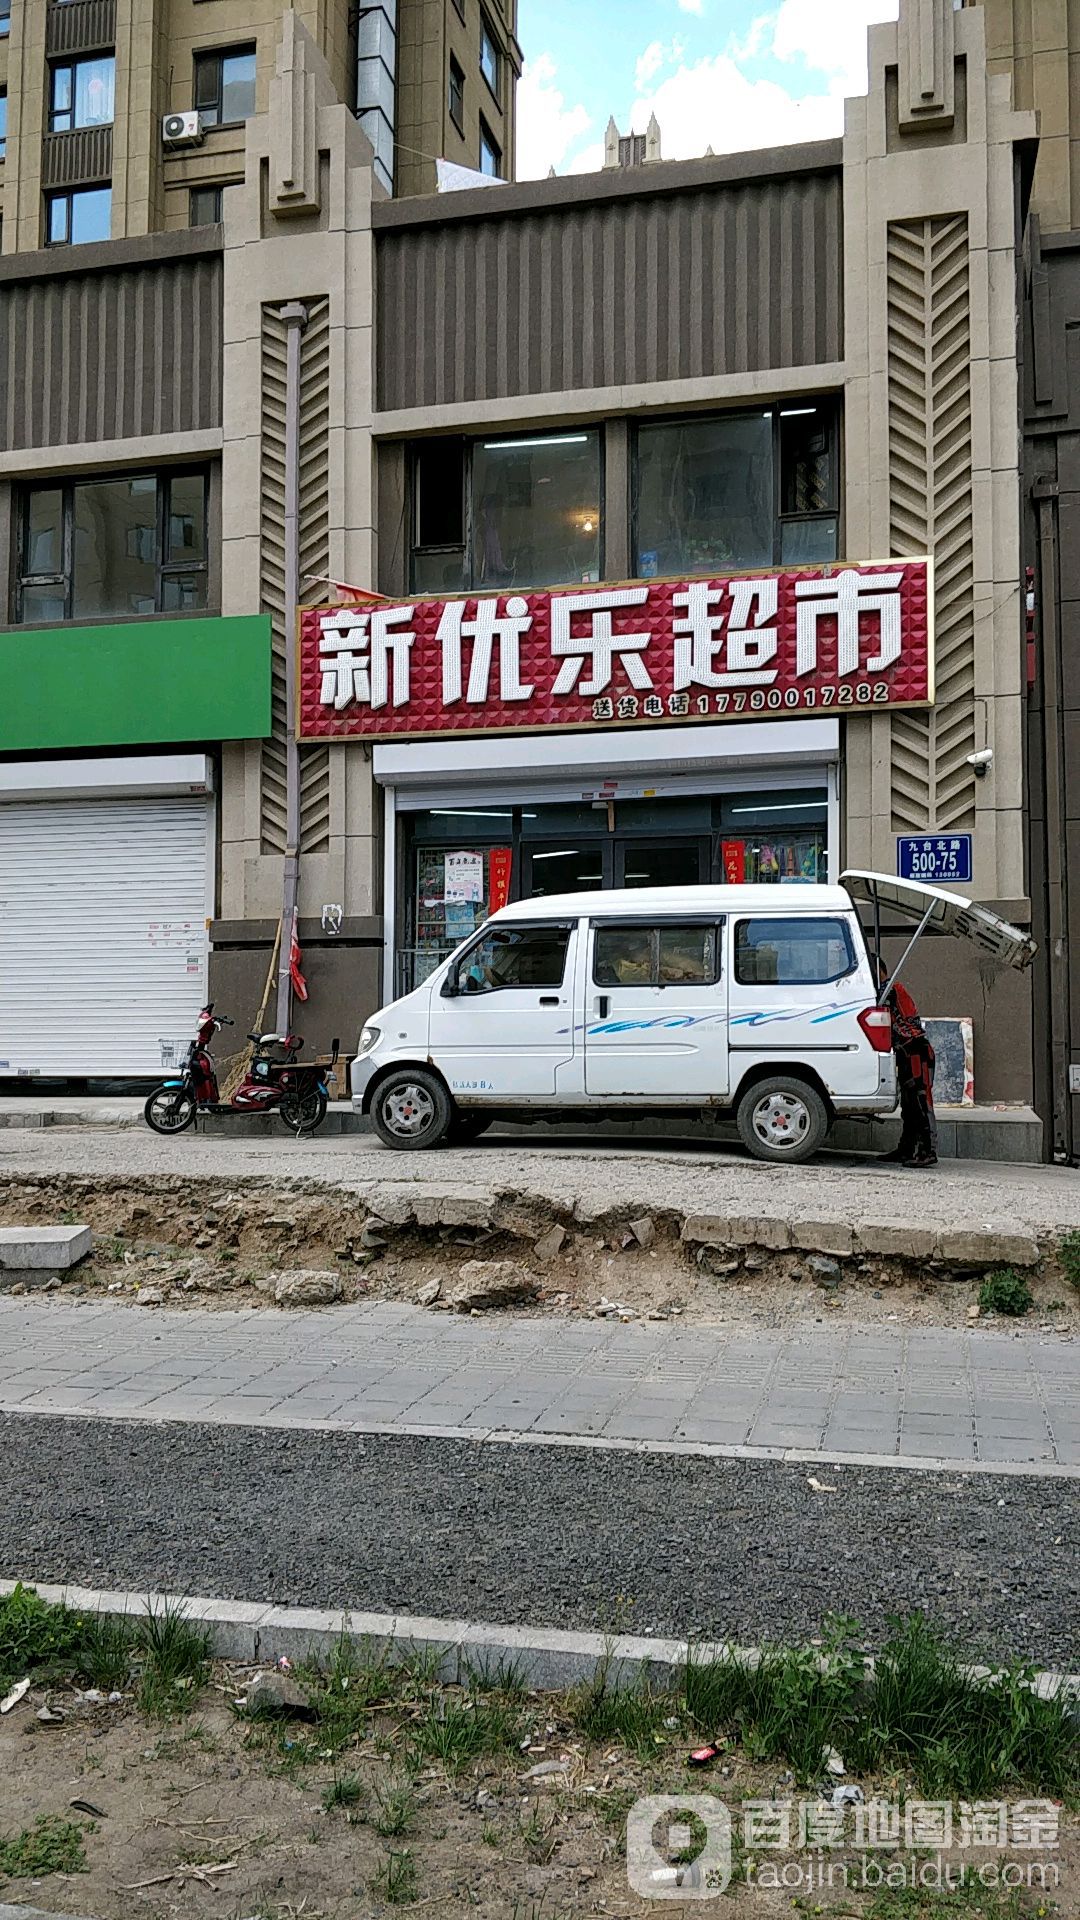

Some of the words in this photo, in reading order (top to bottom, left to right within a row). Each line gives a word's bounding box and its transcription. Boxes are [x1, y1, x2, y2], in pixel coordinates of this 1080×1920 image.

[318, 569, 905, 711] 新优乐超市
[908, 840, 961, 852] 九台北路
[912, 851, 957, 872] 500-75
